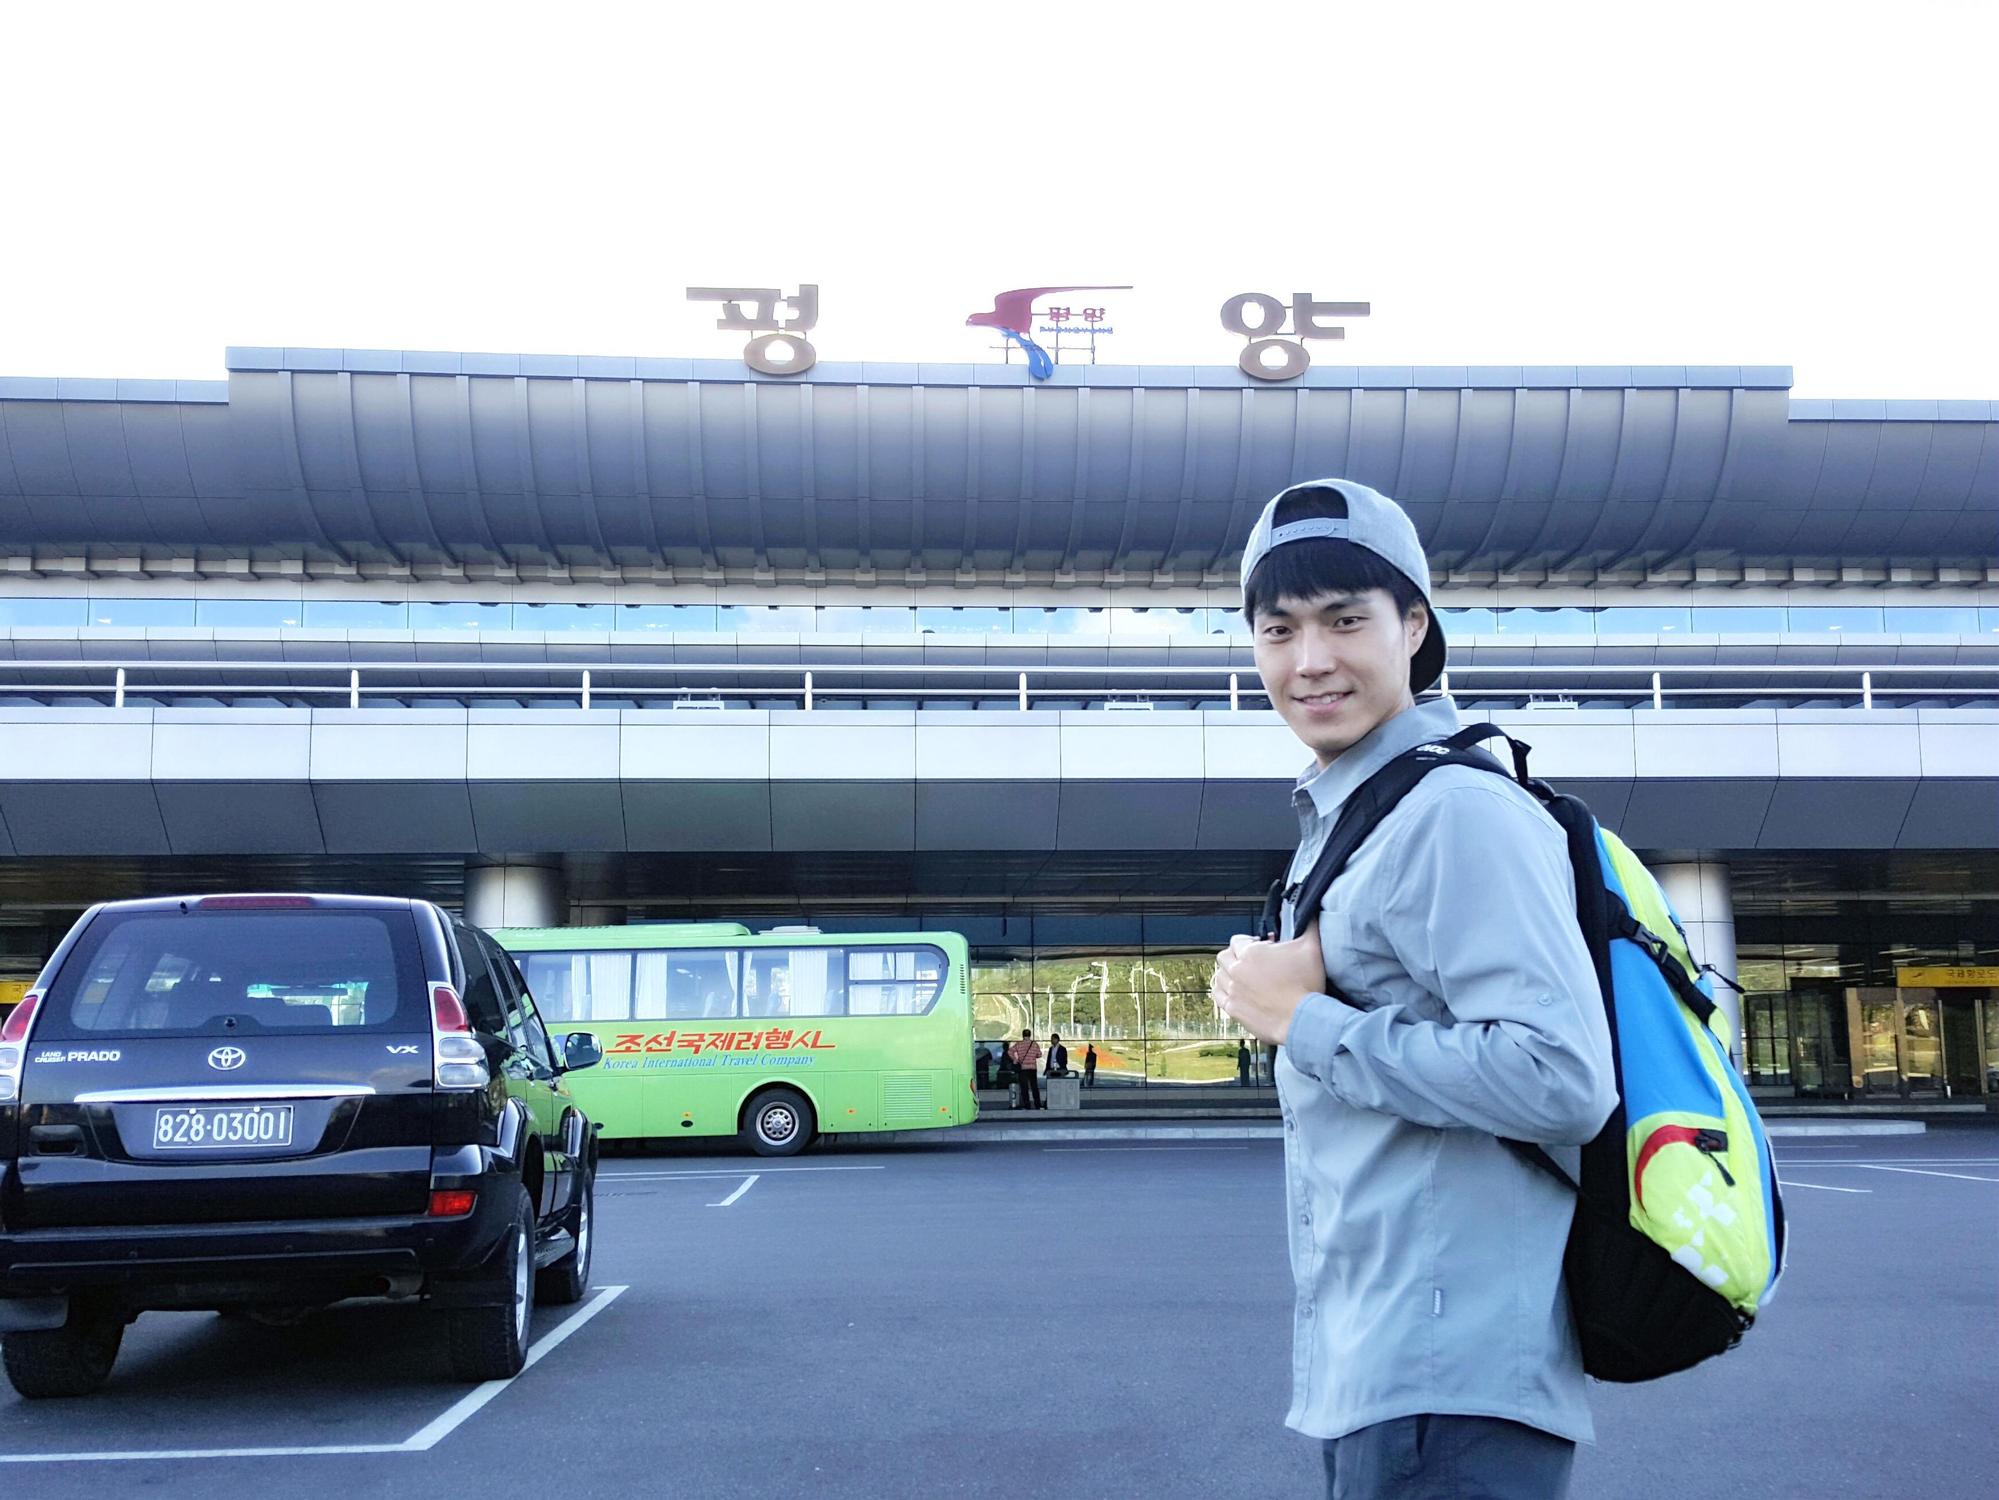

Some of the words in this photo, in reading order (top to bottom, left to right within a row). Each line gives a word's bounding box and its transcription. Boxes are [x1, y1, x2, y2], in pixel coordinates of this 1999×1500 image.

[605, 1028, 837, 1055] 조선국제려행사
[67, 1050, 121, 1062] PRADO
[386, 1045, 419, 1054] VX
[603, 1056, 639, 1069] Korea
[643, 1054, 718, 1068] International
[721, 1053, 759, 1067] Travel
[761, 1053, 815, 1068] Company
